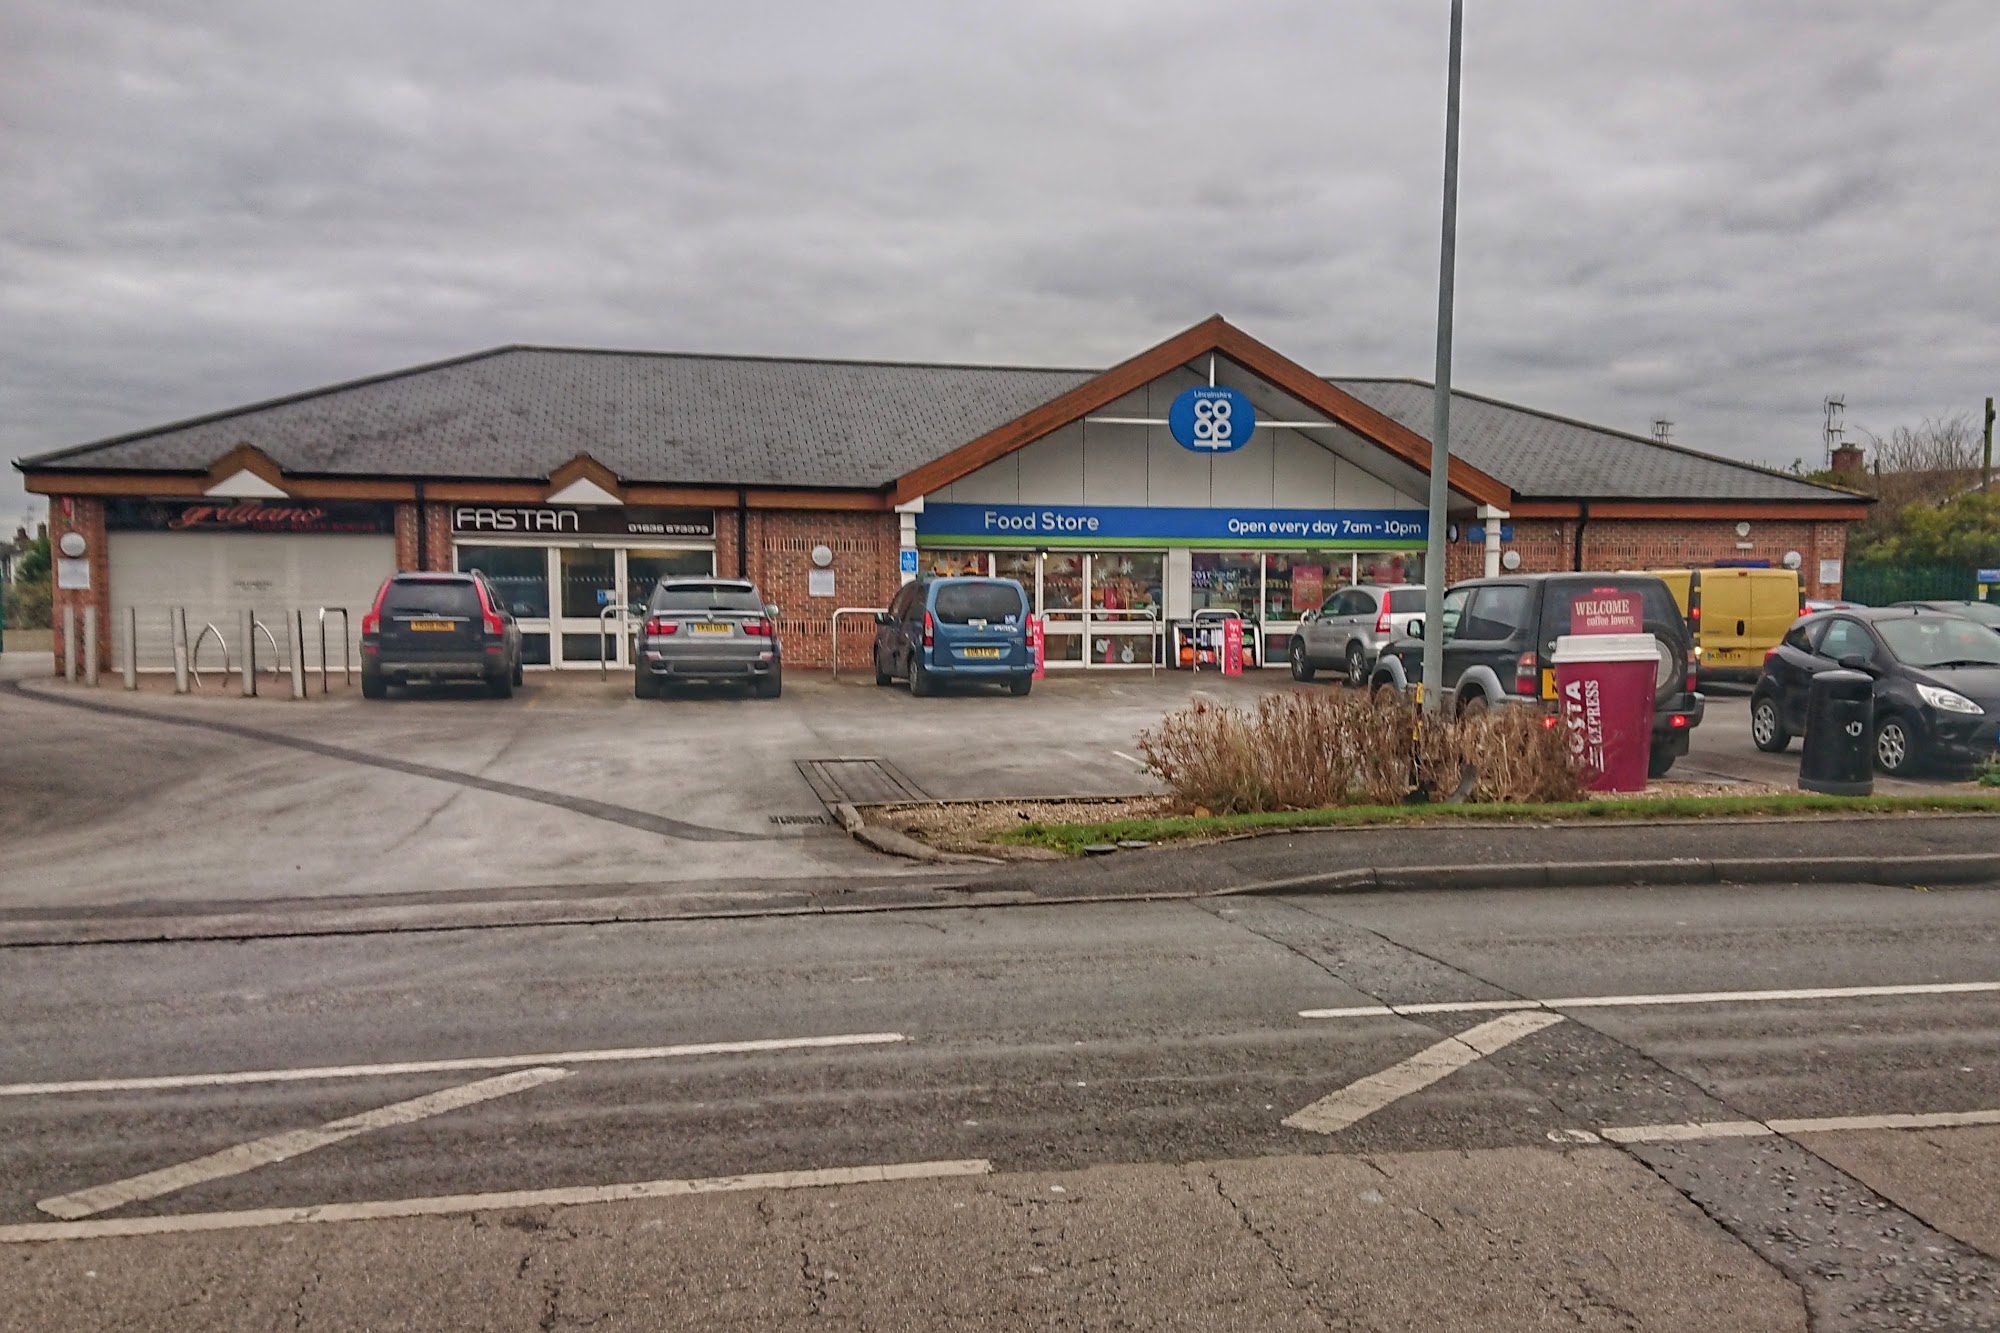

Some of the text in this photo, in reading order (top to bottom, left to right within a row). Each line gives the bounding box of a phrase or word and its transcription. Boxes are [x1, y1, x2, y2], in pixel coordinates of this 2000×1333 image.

[1193, 388, 1232, 399] Lincolnshire
[457, 508, 579, 532] FASTAN
[984, 511, 1099, 531] Food Store
[1228, 518, 1266, 536] Open
[1269, 520, 1309, 537] every
[1312, 519, 1338, 537] day
[1342, 519, 1372, 534] 7am
[1384, 520, 1421, 537] 10pm
[1575, 599, 1630, 616] WELCOME
[1587, 614, 1635, 627] coffee lovers
[1585, 680, 1602, 745] EXPRESS
